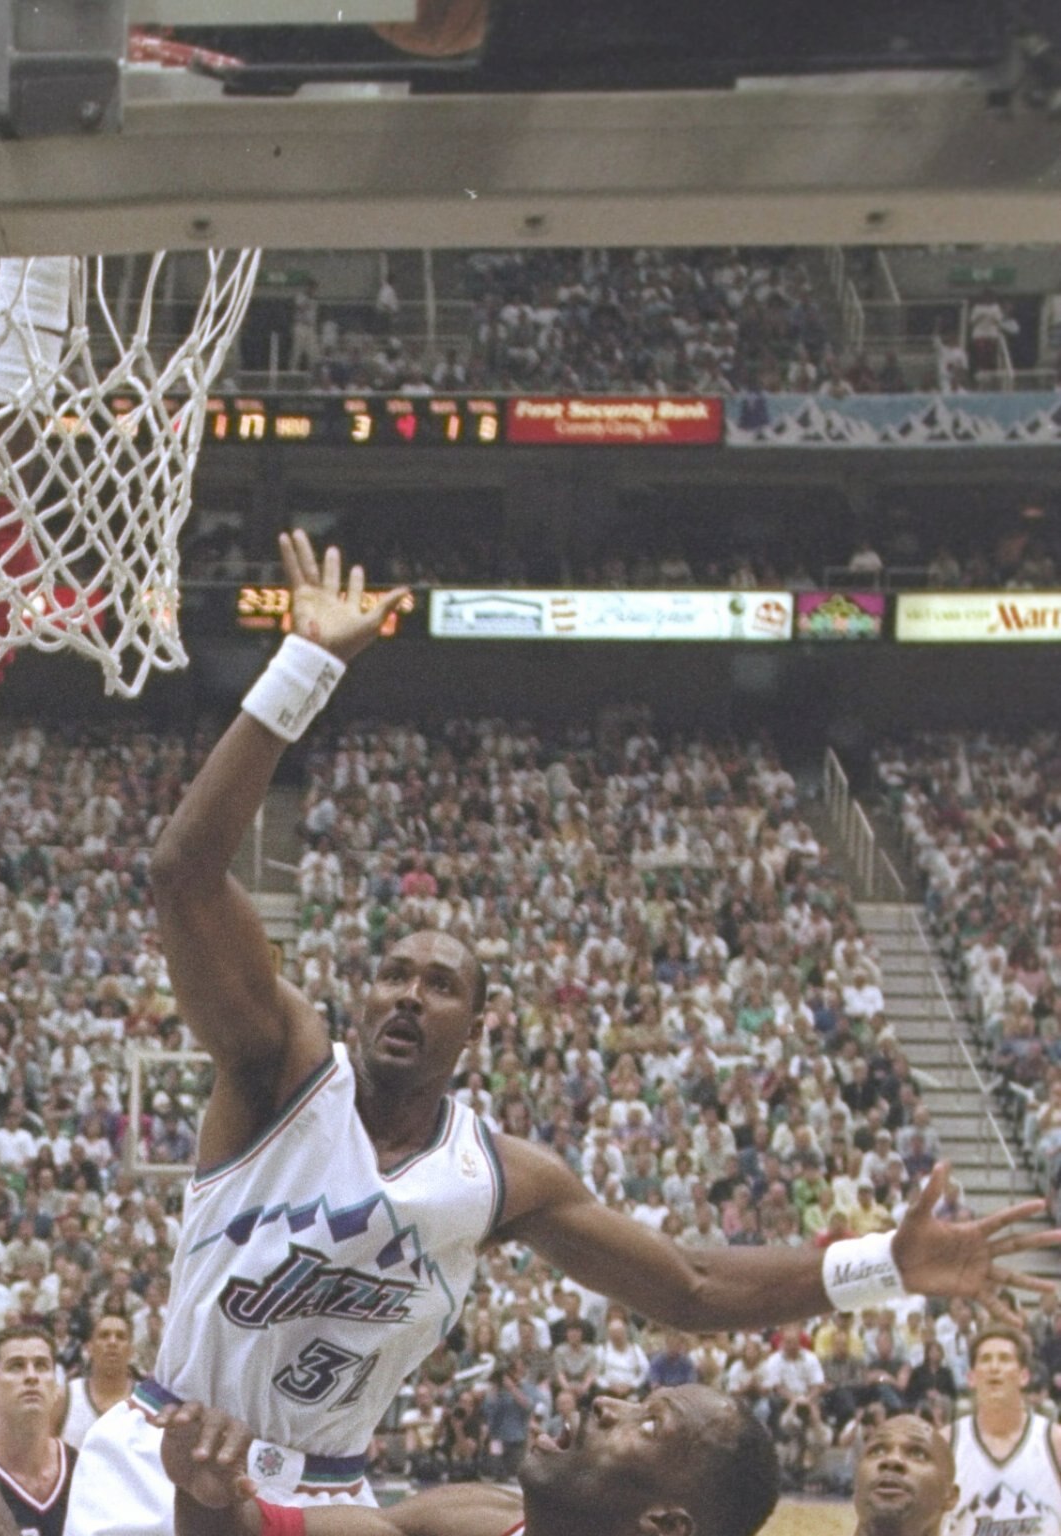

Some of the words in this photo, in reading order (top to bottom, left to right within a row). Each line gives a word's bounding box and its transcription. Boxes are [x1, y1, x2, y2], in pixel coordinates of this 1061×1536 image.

[516, 400, 563, 418] First
[568, 400, 655, 422] Security
[657, 400, 709, 420] Bank
